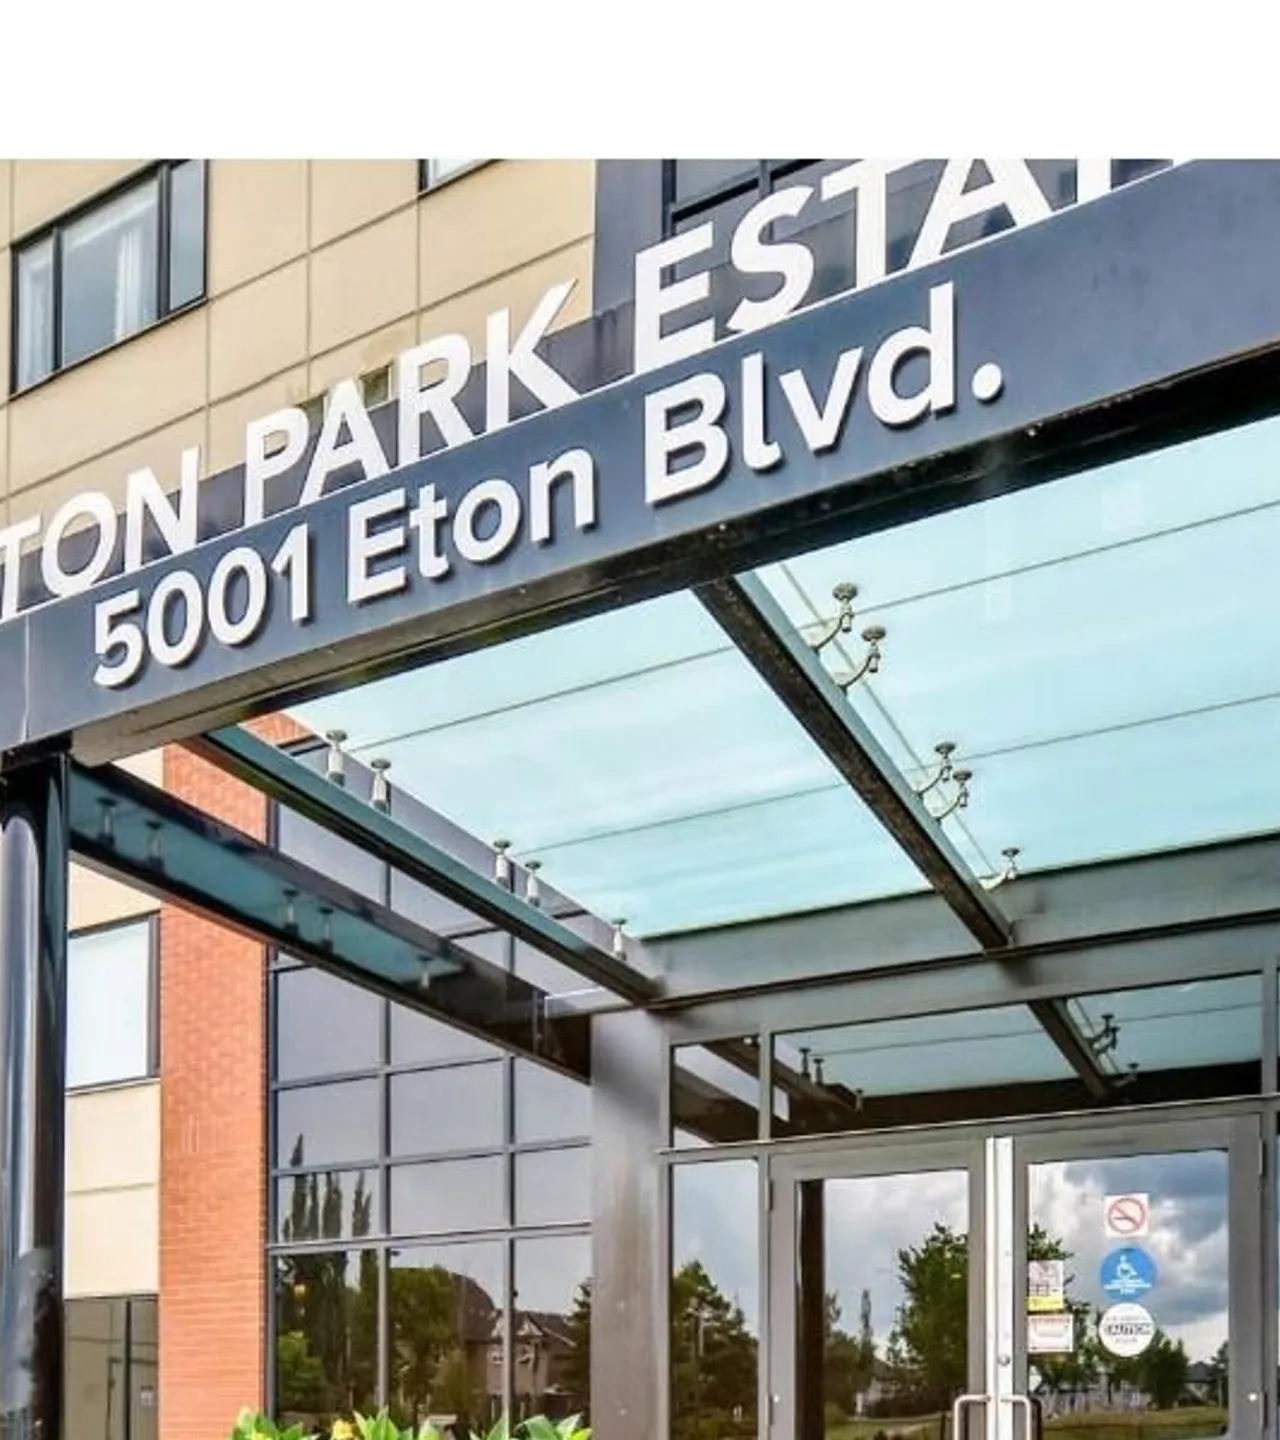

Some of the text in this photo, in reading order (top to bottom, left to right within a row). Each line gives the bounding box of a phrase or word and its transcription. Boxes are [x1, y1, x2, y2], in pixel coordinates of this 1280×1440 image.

[93, 281, 1003, 688] 5001 Eton Blvd.
[244, 279, 585, 527] PARK
[635, 160, 1195, 375] ESTA
